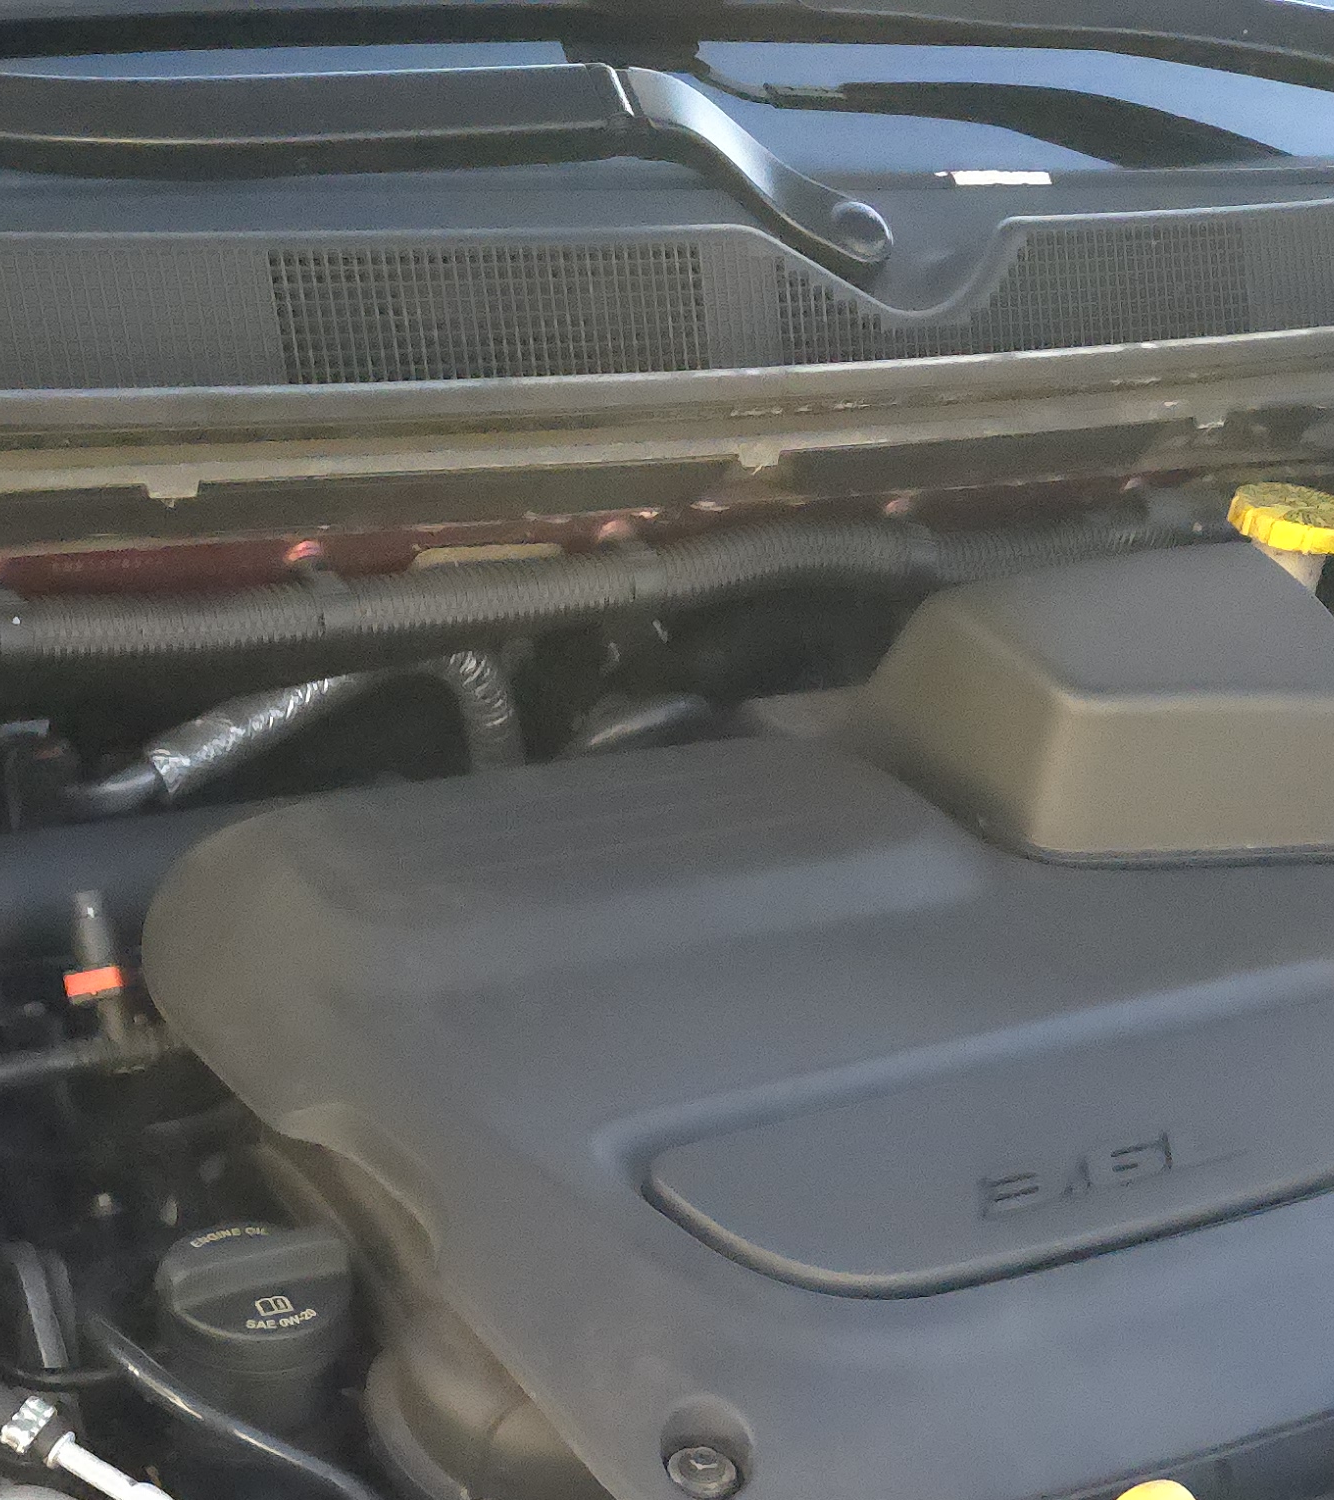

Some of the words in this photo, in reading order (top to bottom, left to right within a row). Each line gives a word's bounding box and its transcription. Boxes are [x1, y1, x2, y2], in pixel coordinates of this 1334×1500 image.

[190, 1227, 242, 1248] ENGINE
[244, 1226, 269, 1238] OIL
[245, 1318, 277, 1330] SAE
[278, 1308, 317, 1328] 0W-20
